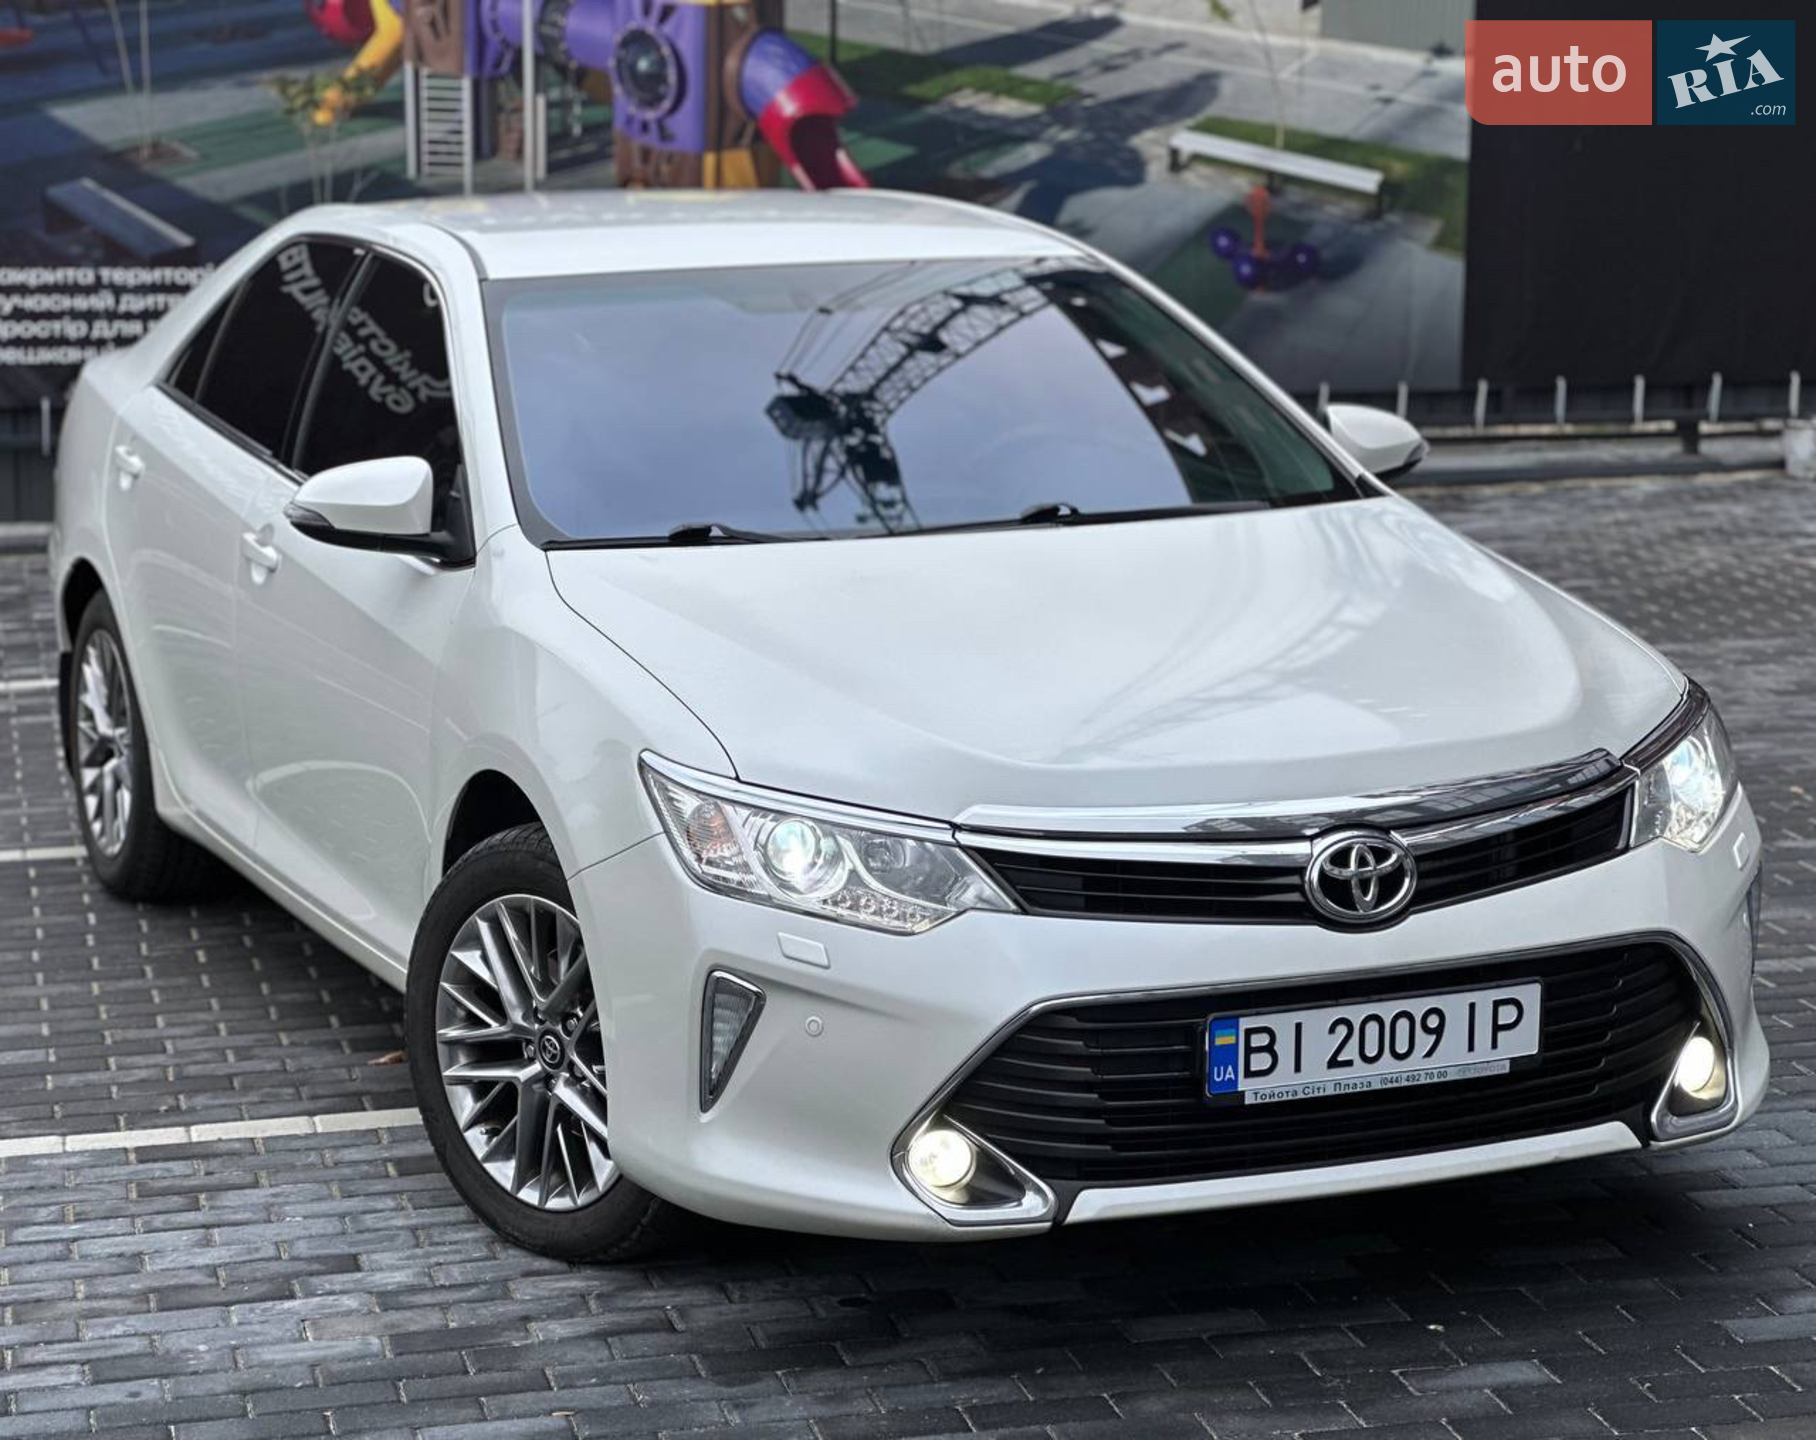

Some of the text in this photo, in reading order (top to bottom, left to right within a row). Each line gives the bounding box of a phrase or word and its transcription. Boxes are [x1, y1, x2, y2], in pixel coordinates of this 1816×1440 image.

[98, 261, 214, 290] територ
[1244, 996, 1525, 1079] BI 2009 IP
[1213, 1064, 1236, 1082] UA
[1253, 1088, 1298, 1102] Тойота
[1333, 1079, 1372, 1093] Плаза
[1380, 1075, 1403, 1087] (044)
[1404, 1072, 1422, 1084] 492
[1437, 1069, 1449, 1080] 00
